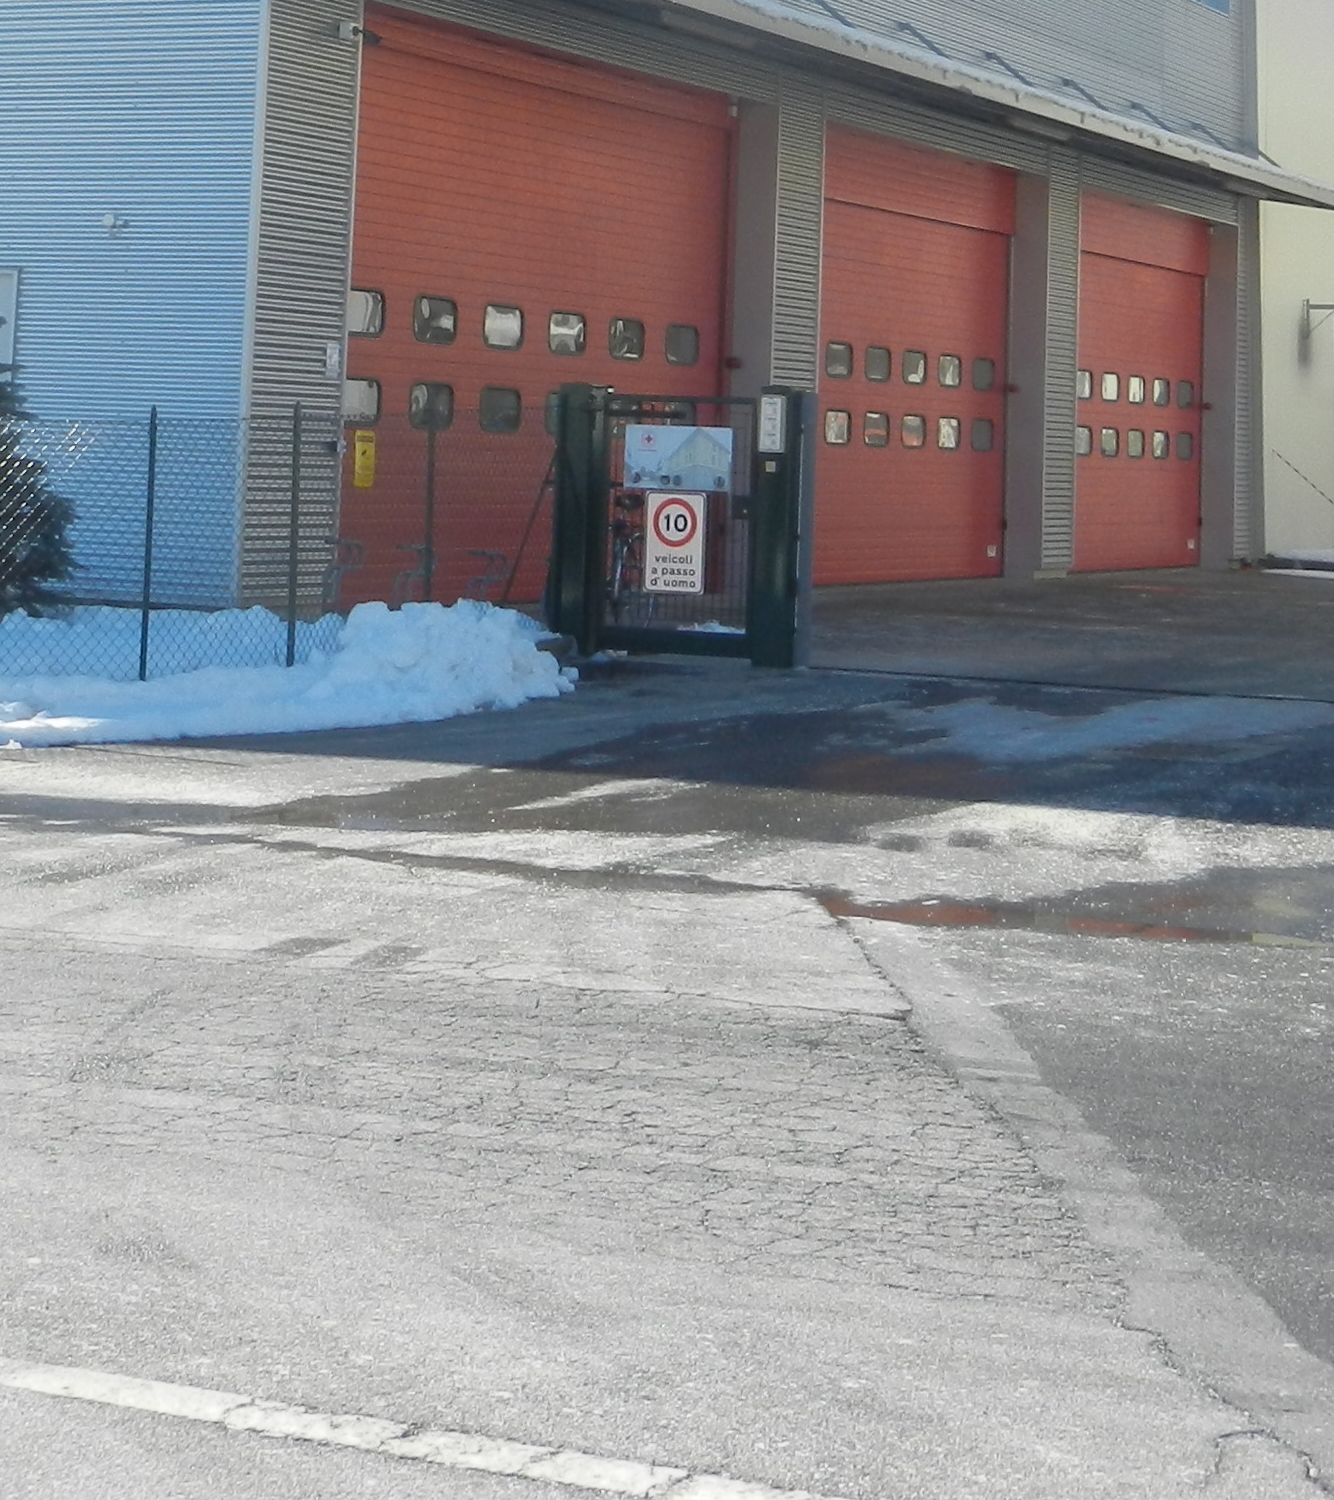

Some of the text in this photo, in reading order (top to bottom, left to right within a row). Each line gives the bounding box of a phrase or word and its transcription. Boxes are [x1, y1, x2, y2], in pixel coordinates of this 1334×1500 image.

[664, 513, 688, 532] 10
[654, 554, 693, 564] veicoli
[651, 567, 696, 576] a passo
[663, 579, 696, 588] uomo
